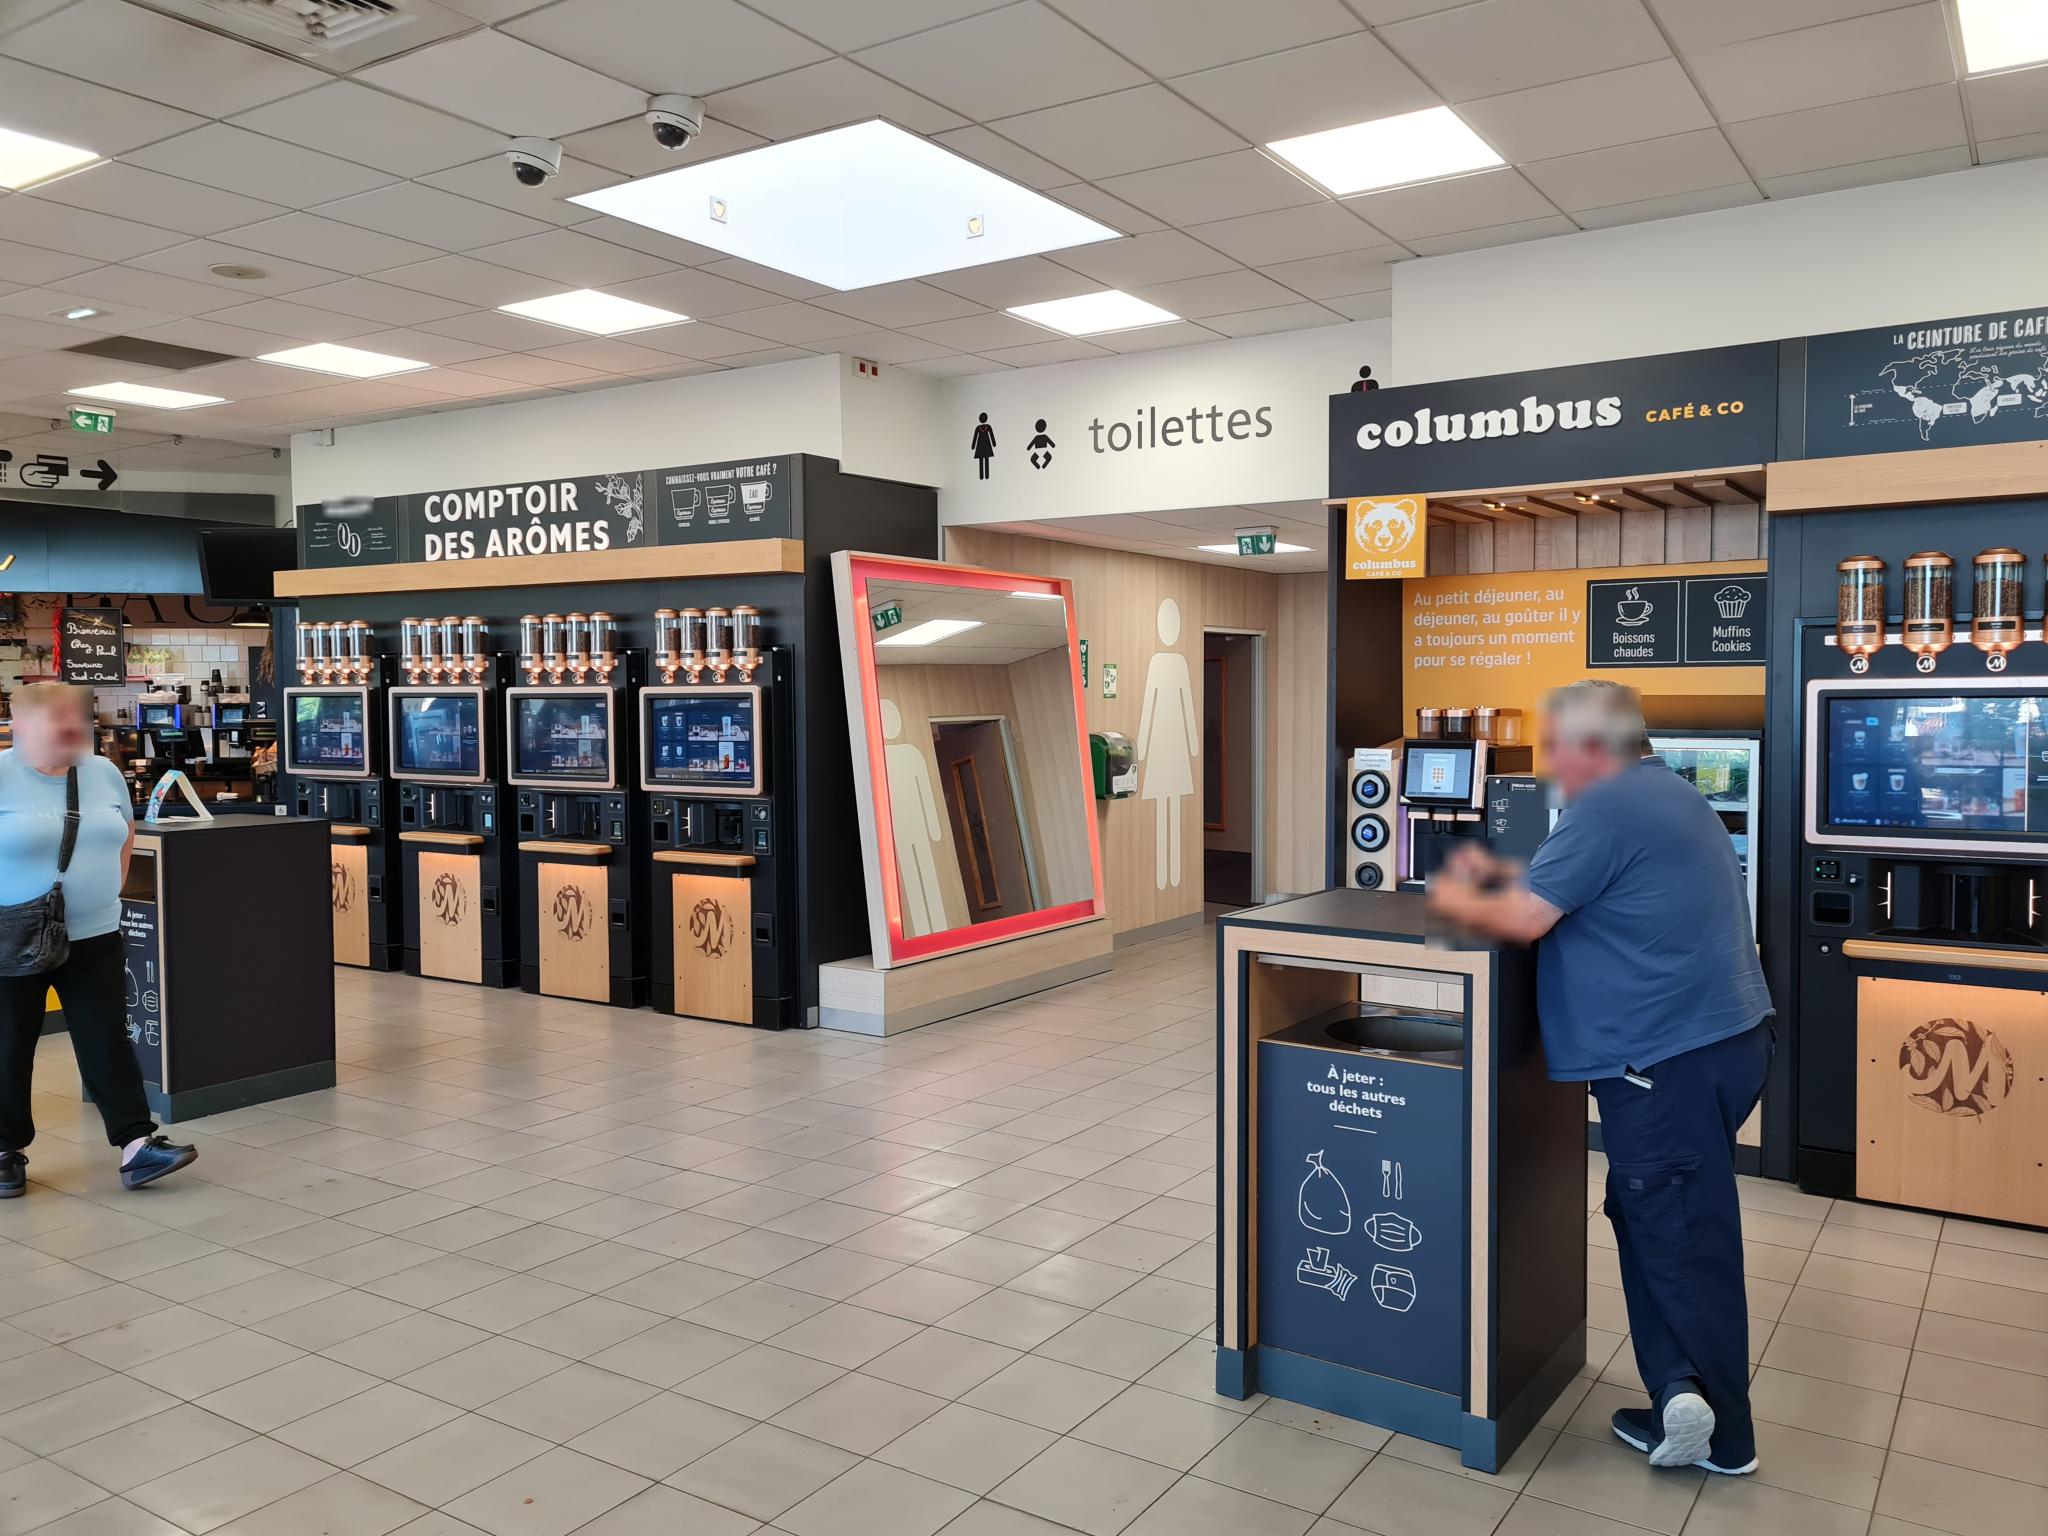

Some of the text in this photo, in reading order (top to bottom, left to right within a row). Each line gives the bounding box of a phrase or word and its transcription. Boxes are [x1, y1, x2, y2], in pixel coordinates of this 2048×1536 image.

[1893, 334, 1904, 345] LA
[1907, 323, 1982, 350] CEINTURE
[1988, 320, 2008, 341] DE
[1645, 401, 1744, 423] CAFÉ & CO
[1088, 405, 1273, 454] toilettes
[1356, 396, 1622, 450] columbus
[665, 462, 777, 485] CONNAISSEZ-VOUS VRAIMENT VOTRE CAFÉ ?
[424, 482, 579, 523] COMPTOIR
[749, 489, 759, 498] EAU
[425, 517, 610, 562] DES ARÔMES
[1353, 559, 1416, 570] columbus
[1414, 588, 1564, 607] Au petit déjeuner, au
[1414, 608, 1581, 628] déjeuner, au goûter il y
[1414, 629, 1575, 649] a toujours un moment
[1613, 632, 1655, 644] Boissons
[1713, 625, 1751, 638] Muffins
[1613, 646, 1654, 658] chaudes
[1712, 639, 1751, 652] Cookies
[1414, 651, 1531, 669] pour se régaler !
[1327, 1063, 1384, 1087] À jeter :
[1306, 1080, 1406, 1106] tous les autres
[1328, 1099, 1383, 1119] déchets
